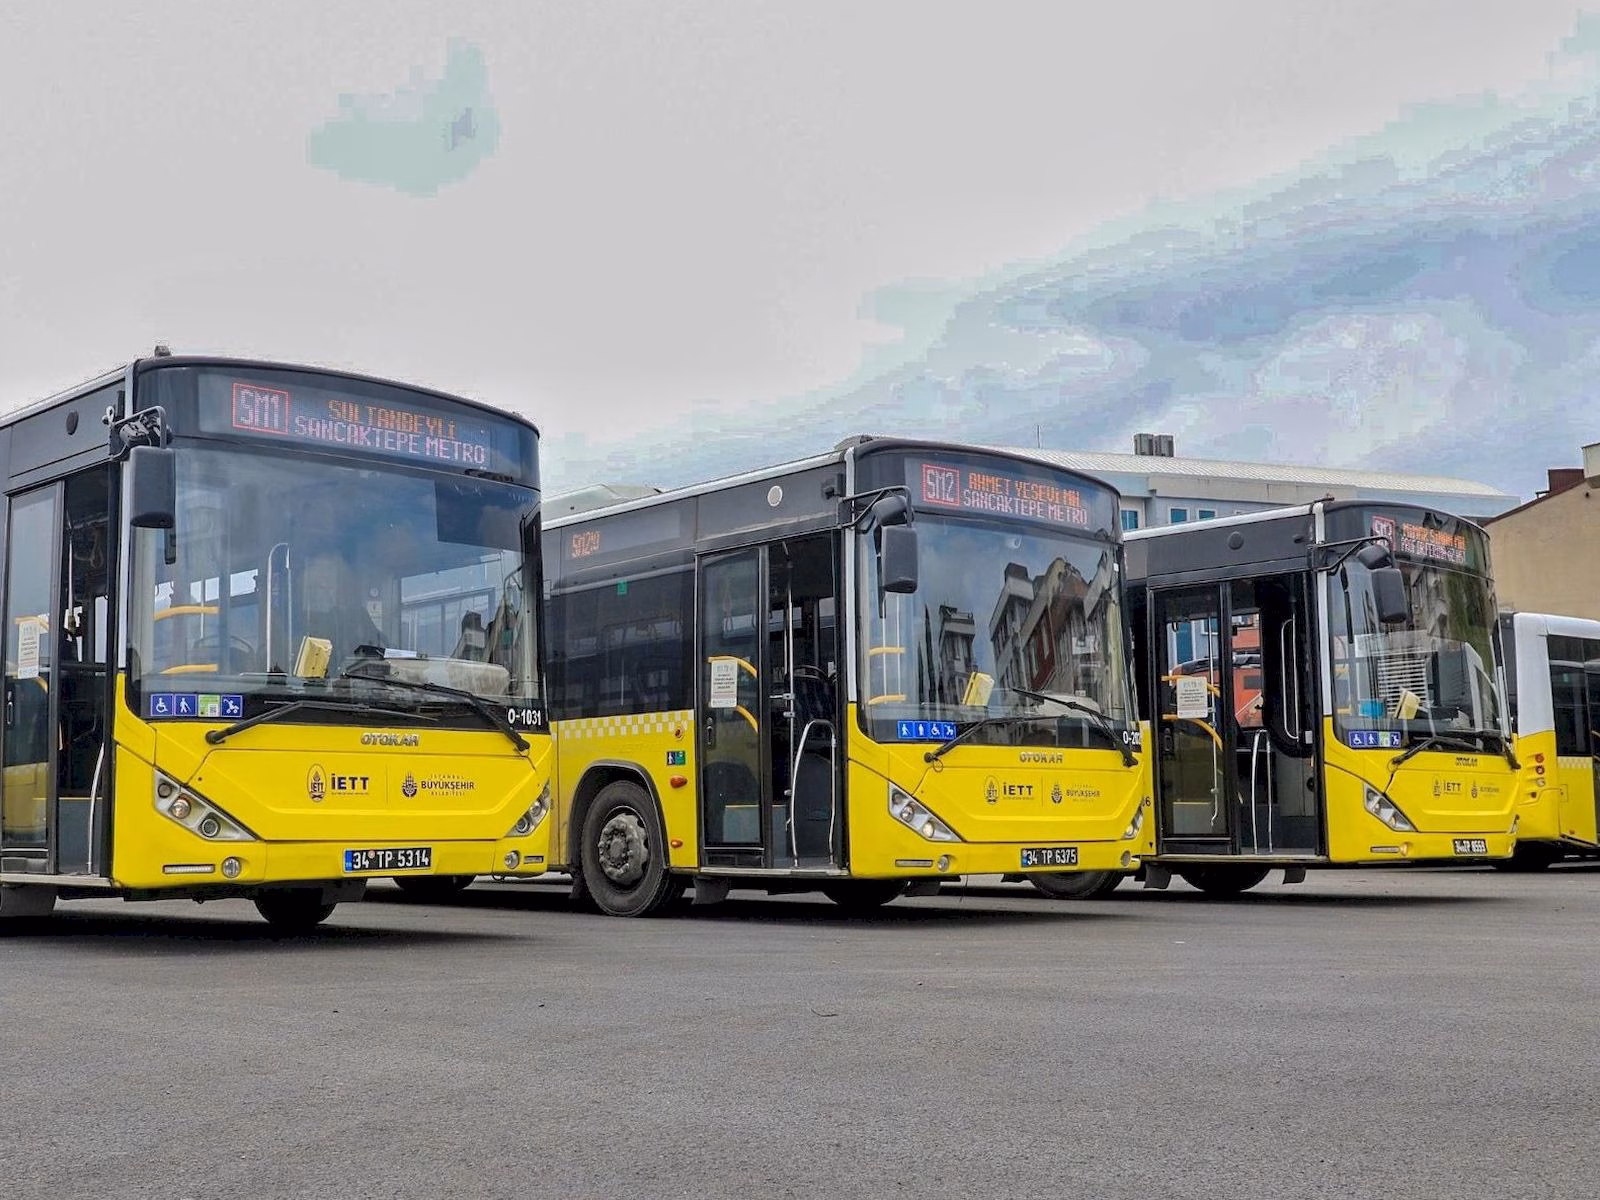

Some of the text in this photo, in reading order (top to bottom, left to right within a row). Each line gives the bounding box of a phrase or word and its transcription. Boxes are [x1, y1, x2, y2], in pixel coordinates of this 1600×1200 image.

[294, 414, 485, 464] SANCAKTEPE METRO
[926, 469, 955, 502] SM2
[968, 472, 1010, 495] AHMET
[963, 489, 1088, 525] SANCAKTEPE METRO
[361, 732, 420, 747] OTOKAR
[331, 773, 369, 790] İETT
[1003, 782, 1034, 796] İETT
[353, 850, 429, 869] 34 TP 5314
[1027, 849, 1077, 865] 34 TP 6375
